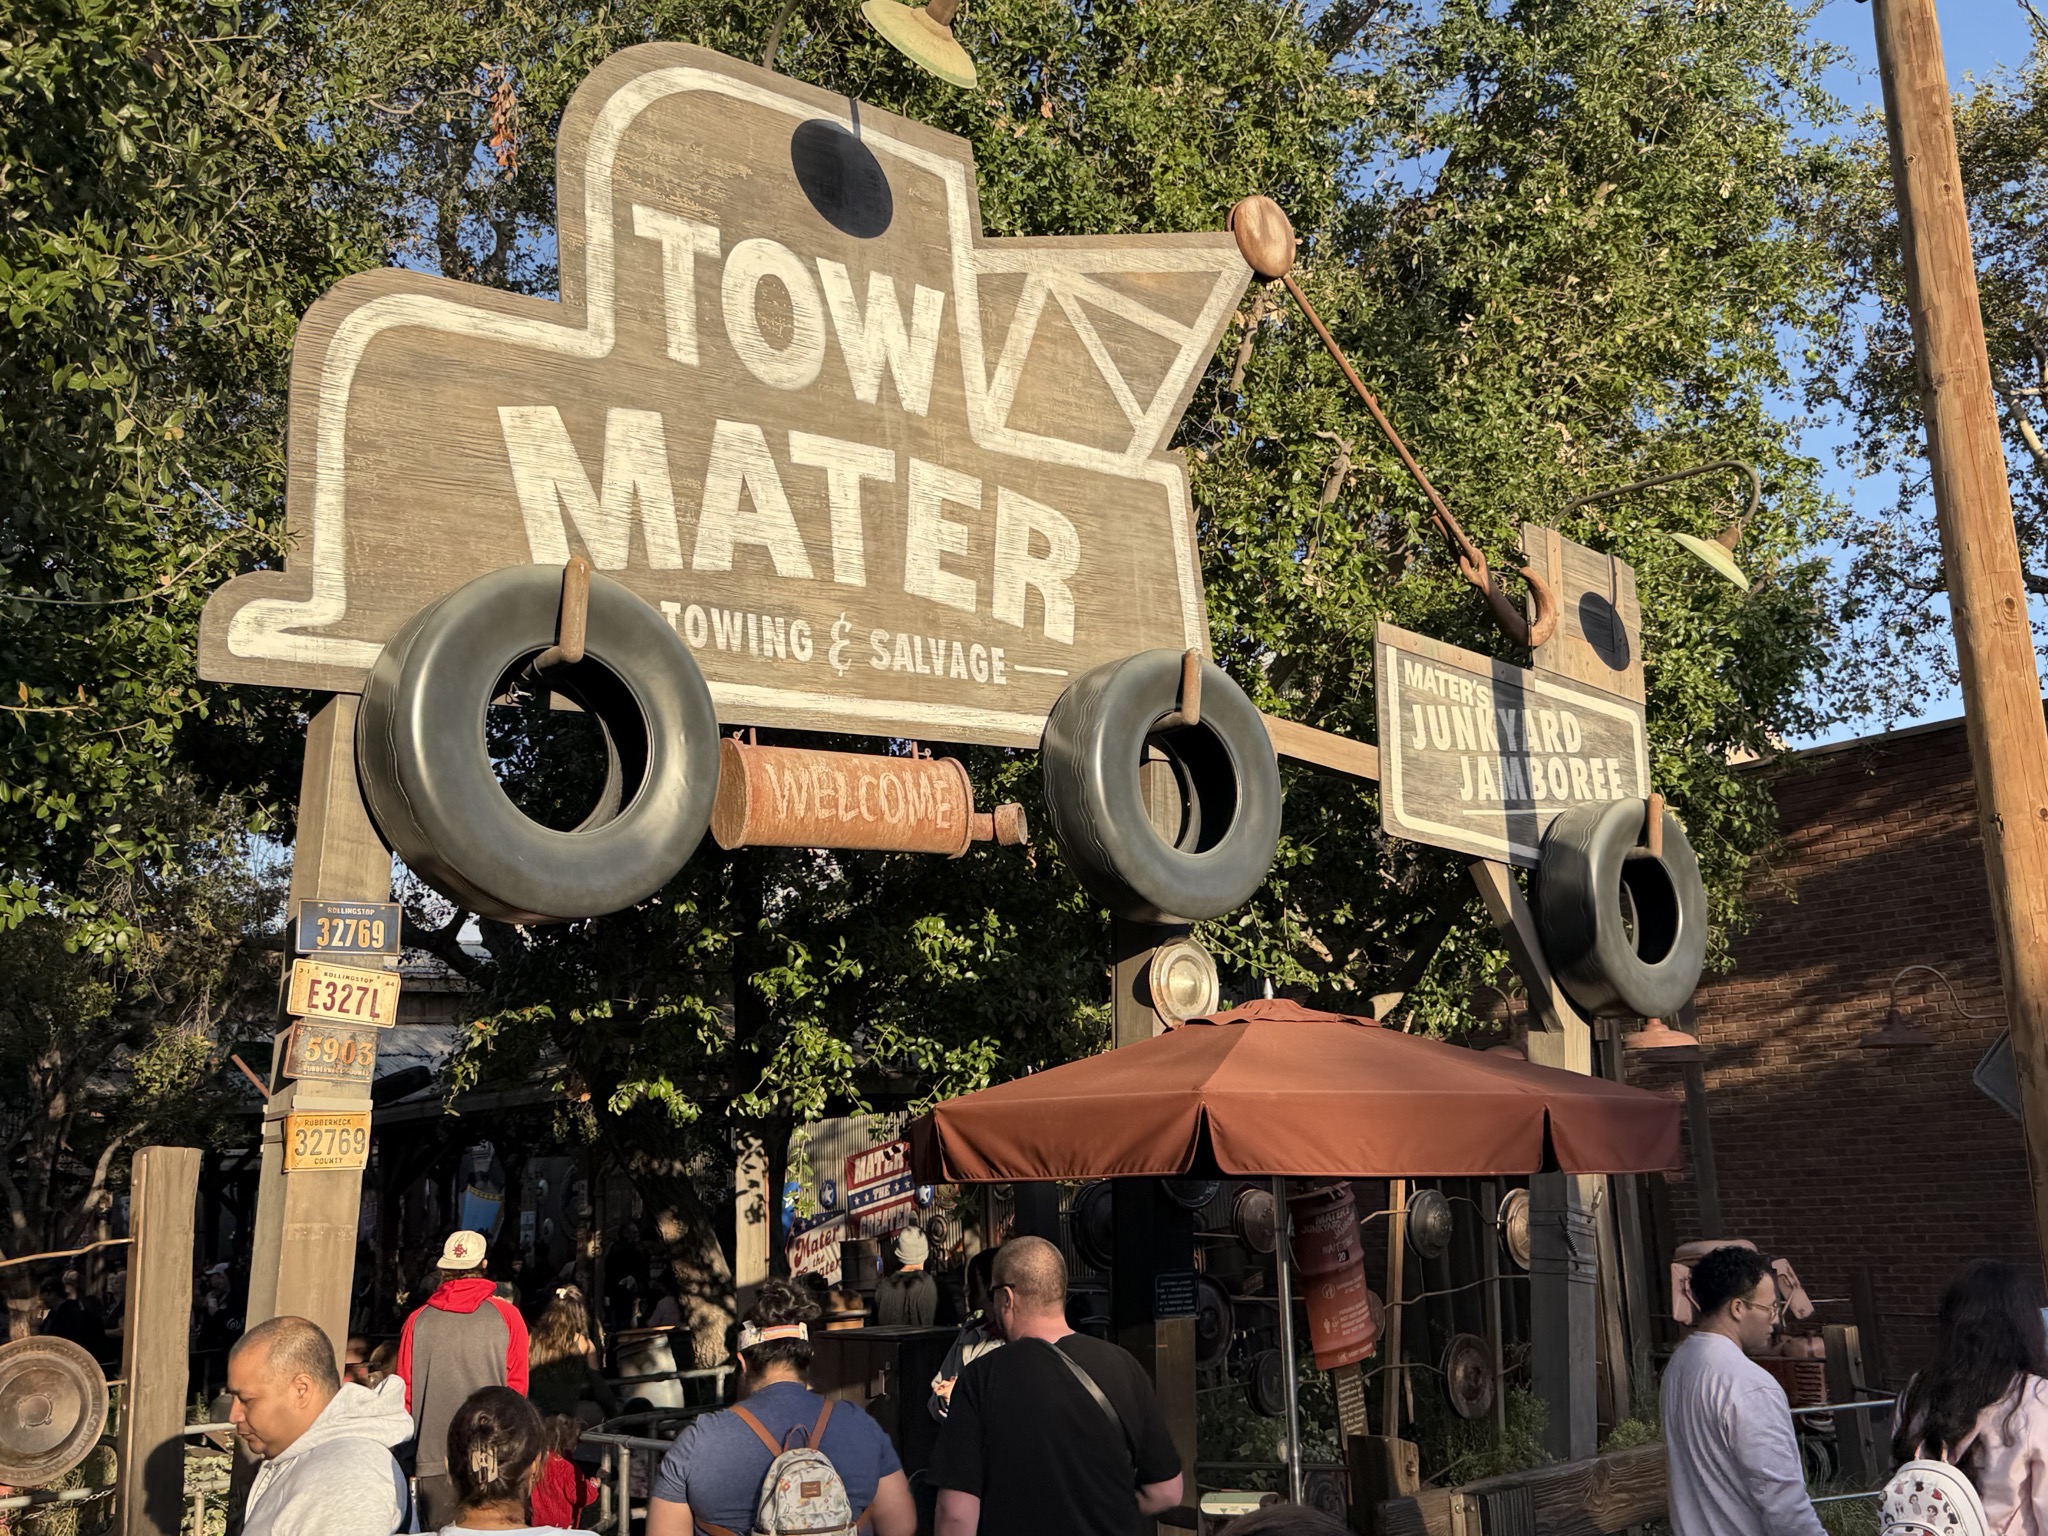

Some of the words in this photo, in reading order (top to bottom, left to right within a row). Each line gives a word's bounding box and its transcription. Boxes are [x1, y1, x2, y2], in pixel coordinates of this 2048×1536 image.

[631, 203, 946, 417] TOW
[497, 404, 1081, 645] MATER
[661, 601, 813, 663] TOWING
[828, 611, 853, 677] &
[870, 628, 1008, 686] SALVAGE
[1404, 661, 1490, 709] MATER'S
[1412, 704, 1582, 753] JUNKYARD
[1460, 756, 1624, 801] JAMBOREE
[764, 762, 952, 830] WELCOME
[327, 906, 375, 916] ROLLINGSTOP
[316, 917, 385, 949] 32769
[323, 971, 374, 984] ROLLINGSTOP
[307, 978, 380, 1019] E327L
[304, 1036, 374, 1066] 5903
[304, 1118, 352, 1126] RUBBERNECK
[294, 1127, 366, 1156] 32769
[314, 1157, 343, 1165] COUNTY
[872, 1184, 891, 1201] THE
[794, 1224, 840, 1268] Mater
[812, 1254, 825, 1268] the
[1337, 1251, 1346, 1263] 20
